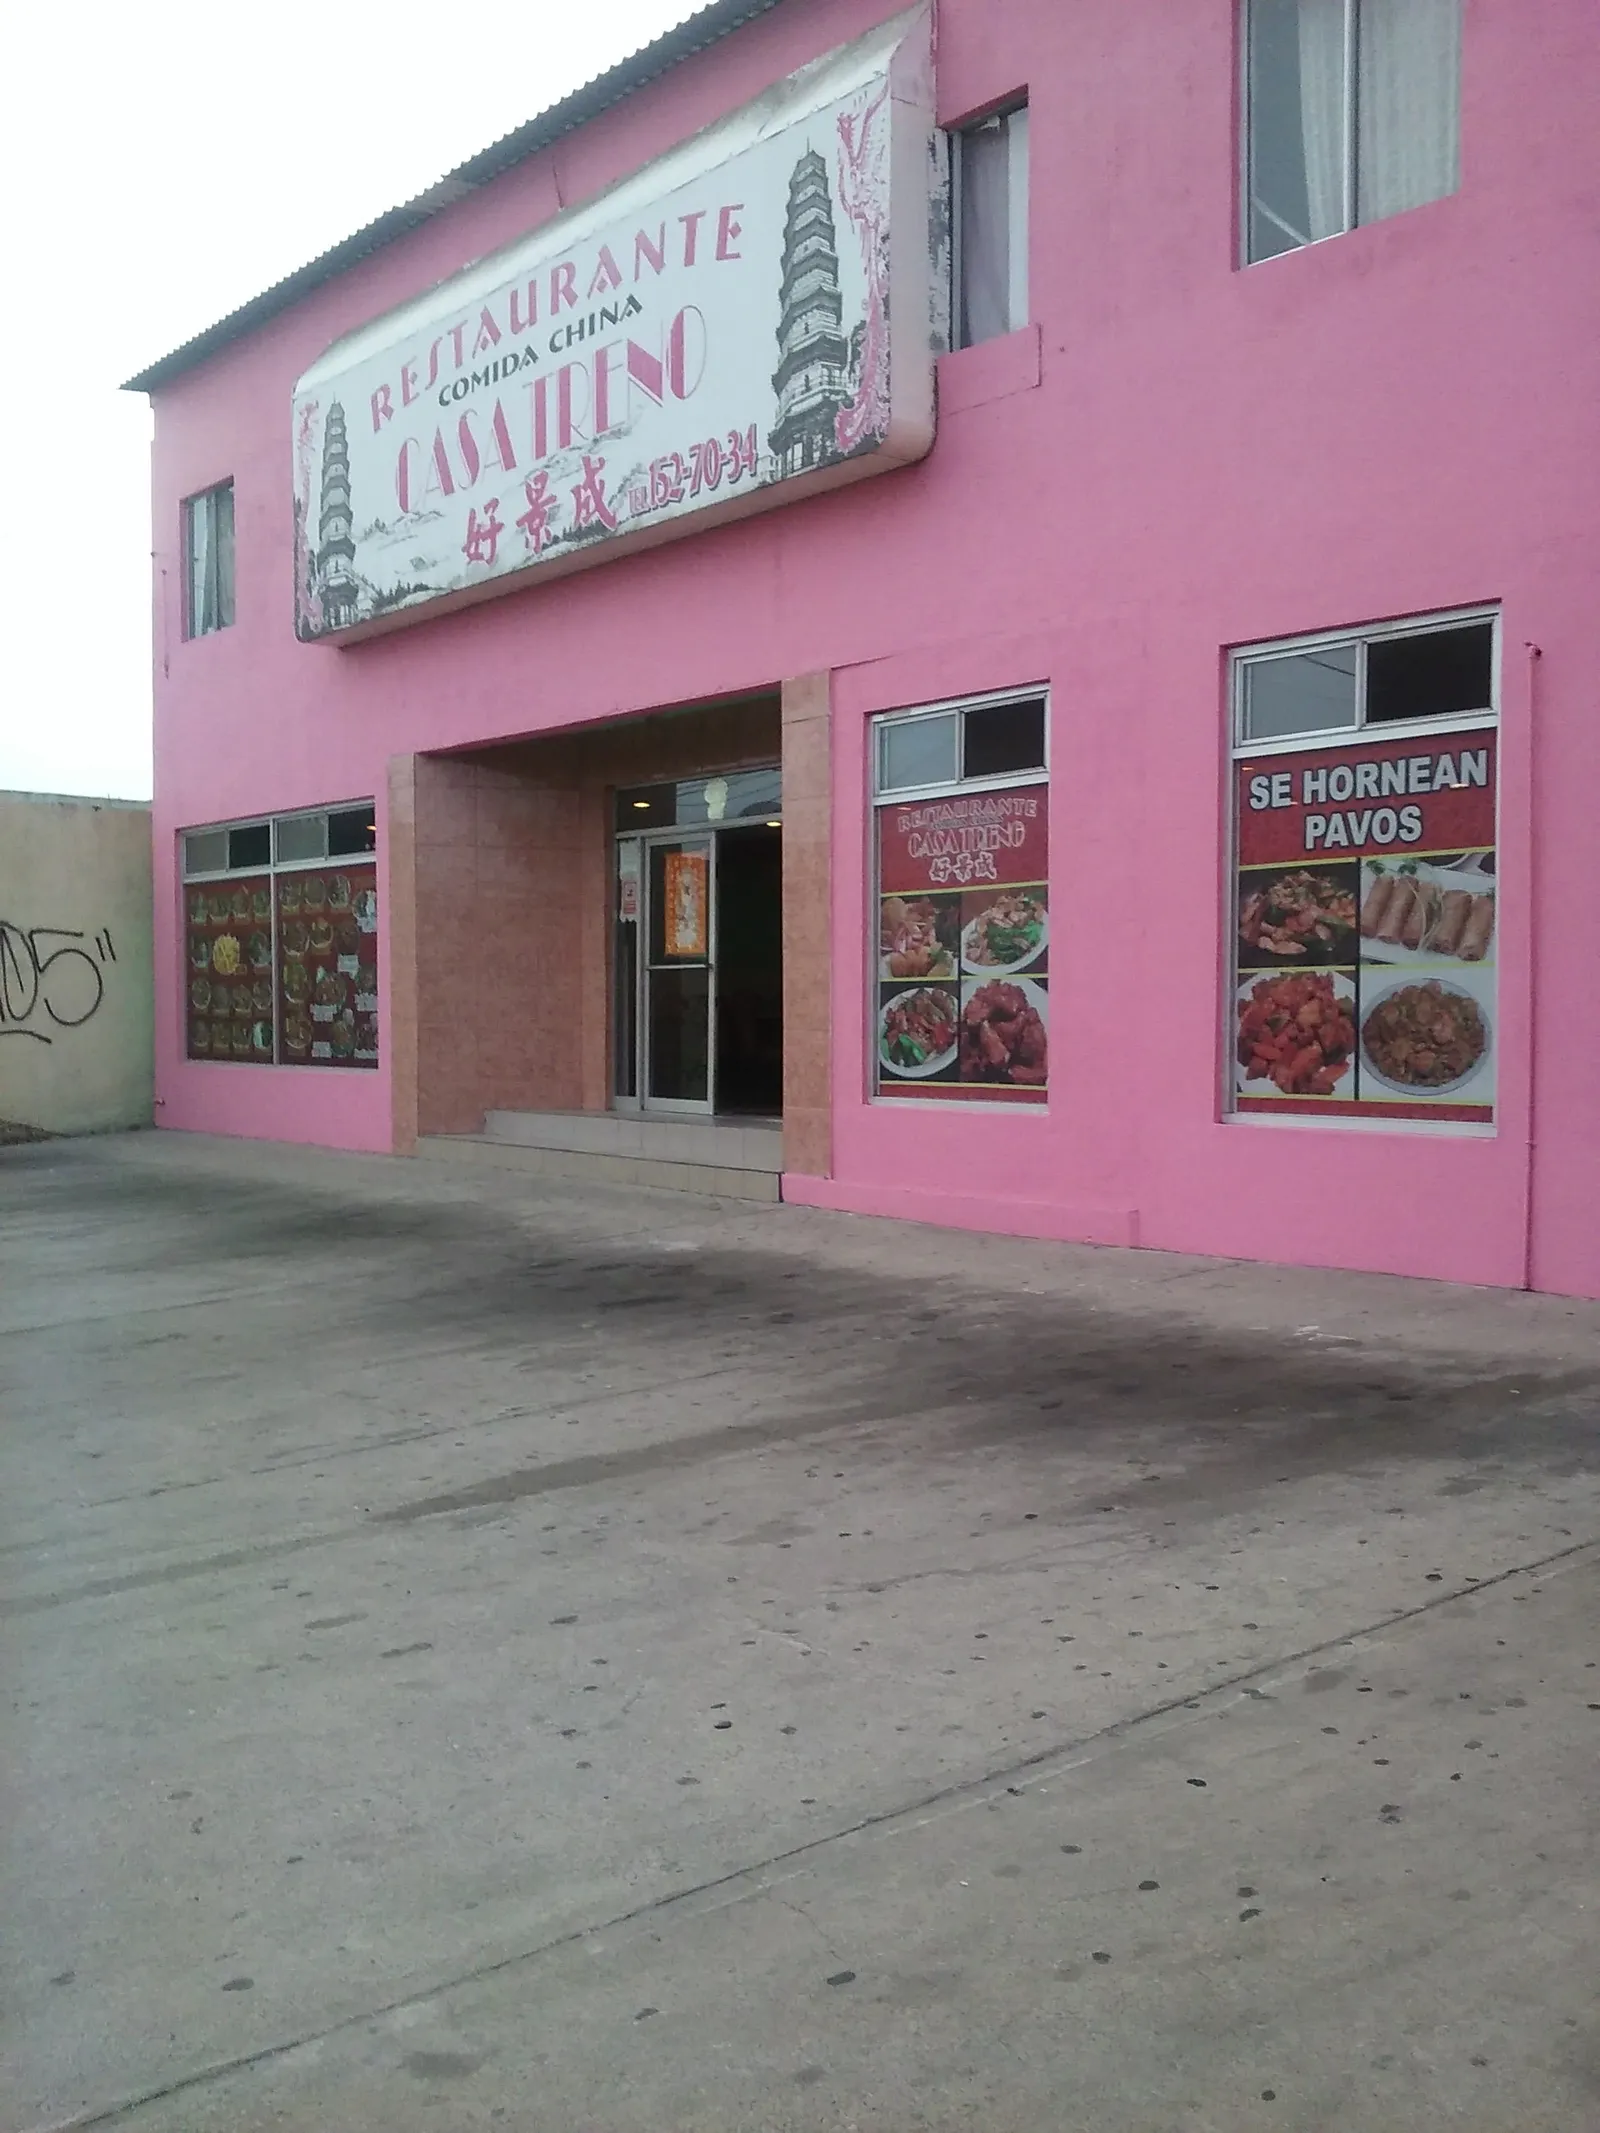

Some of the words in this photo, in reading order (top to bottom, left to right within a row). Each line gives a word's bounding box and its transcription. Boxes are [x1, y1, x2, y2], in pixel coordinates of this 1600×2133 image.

[370, 203, 744, 434] RESTAURANTE
[438, 345, 539, 407] COMIDA
[549, 293, 643, 353] CHINA
[1249, 773, 1292, 810] SE
[1302, 750, 1488, 805] HORNEAN
[1304, 805, 1423, 850] PAVOS
